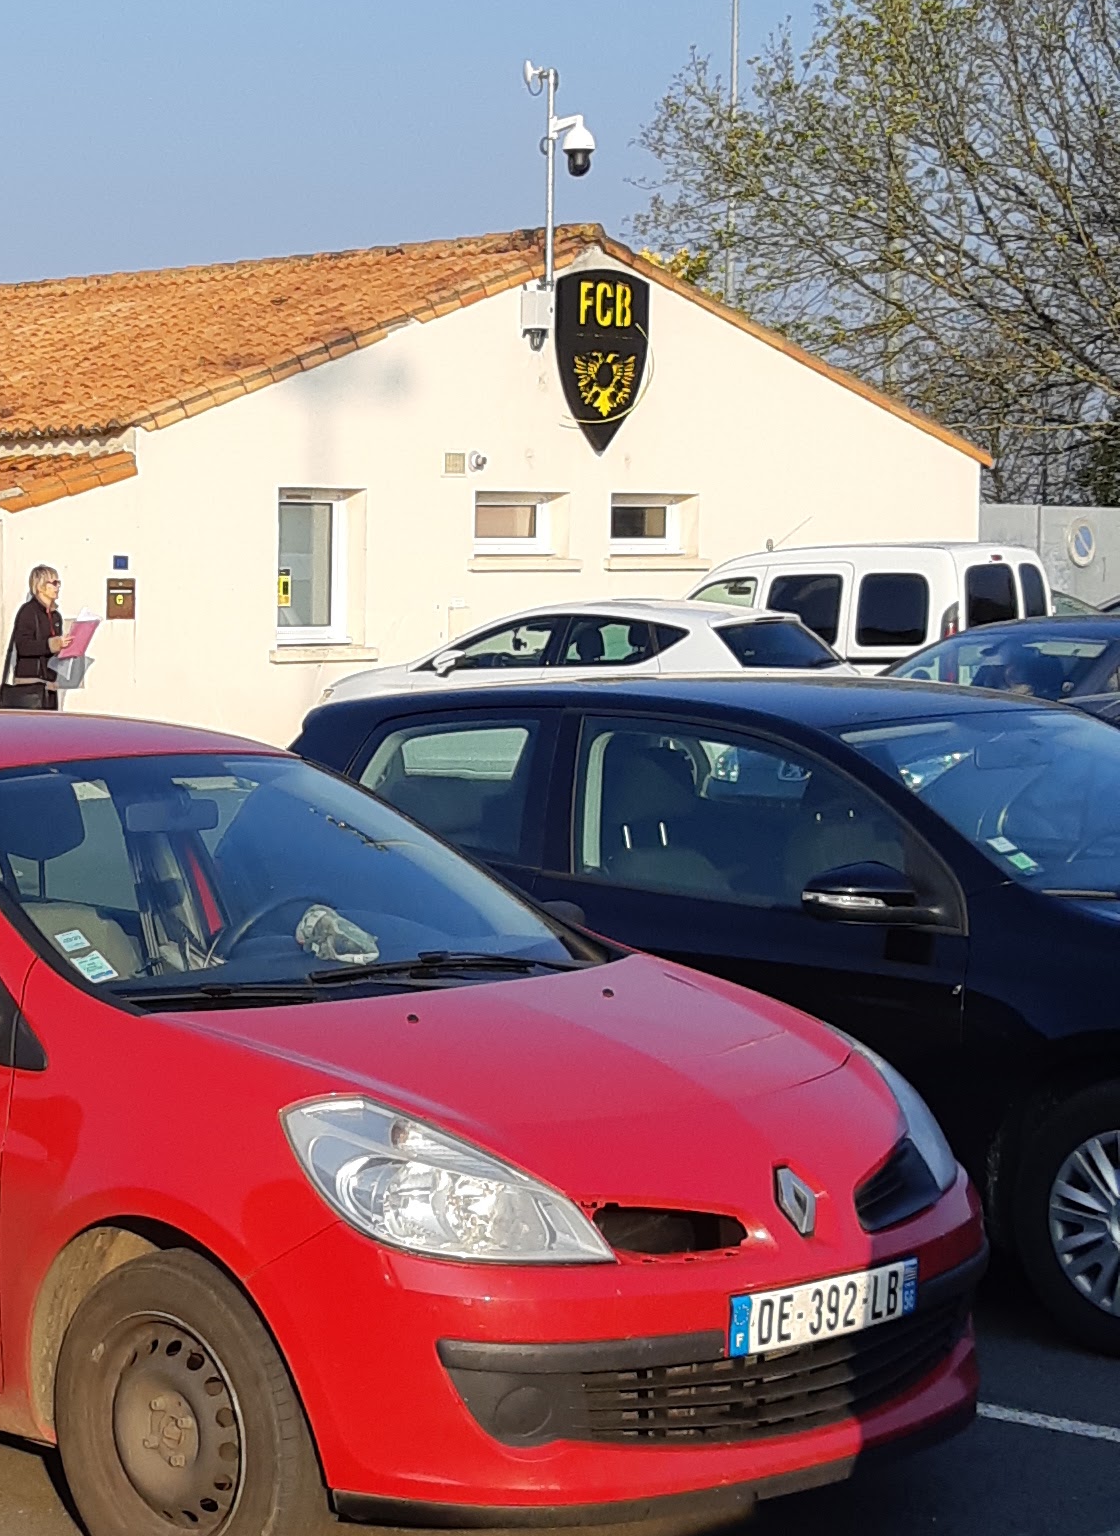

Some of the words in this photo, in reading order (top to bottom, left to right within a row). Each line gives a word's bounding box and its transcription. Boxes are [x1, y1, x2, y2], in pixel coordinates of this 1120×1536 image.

[579, 280, 633, 327] FCB
[757, 1270, 899, 1346] DE-392-LB
[735, 1333, 745, 1348] F
